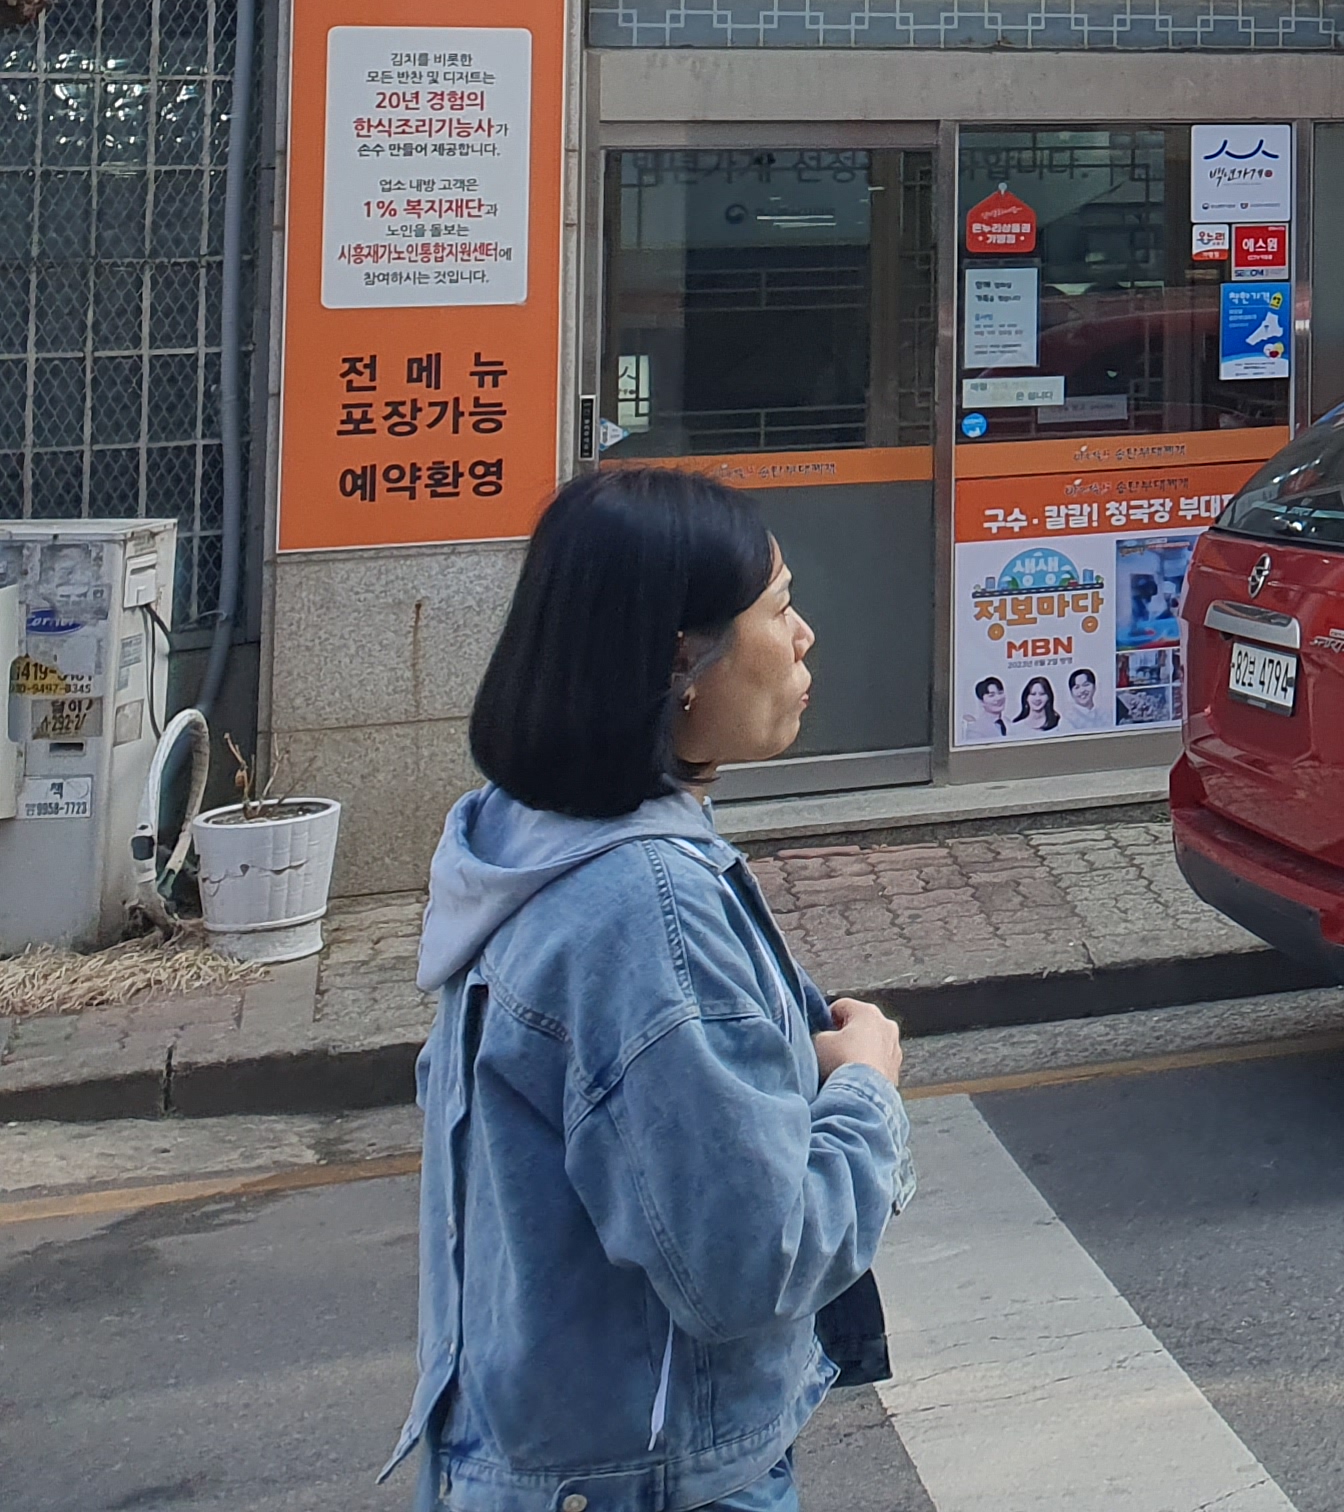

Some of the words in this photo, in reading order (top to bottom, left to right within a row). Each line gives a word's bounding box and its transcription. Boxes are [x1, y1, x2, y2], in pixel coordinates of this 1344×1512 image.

[433, 53, 473, 67] 비롯한
[366, 71, 394, 84] 모든
[397, 71, 424, 85] 반찬
[427, 71, 440, 85] 및
[443, 71, 496, 85] 디저트는
[375, 90, 420, 111] 20년
[426, 90, 486, 112] 경험의
[352, 117, 509, 138] 한식조리기능사가
[357, 143, 385, 157] 손수
[388, 143, 428, 157] 만들어
[431, 142, 501, 157] 제공합니다.
[379, 178, 406, 192] 업소
[409, 178, 436, 192] 내방
[440, 178, 479, 192] 고객은
[363, 199, 398, 218] 1%
[403, 198, 498, 218] 복지재단과
[363, 271, 430, 286] 참여하시는
[433, 270, 490, 285] 것입니다.
[336, 396, 508, 438] 포장가능
[339, 458, 504, 503] 예약환영
[1105, 497, 1173, 527] 청국장
[1178, 493, 1235, 520] 부대
[1012, 554, 1060, 586] 생생
[973, 591, 1105, 642] 정보마당
[1006, 635, 1073, 659] MBN
[1258, 659, 1291, 700] 4794
